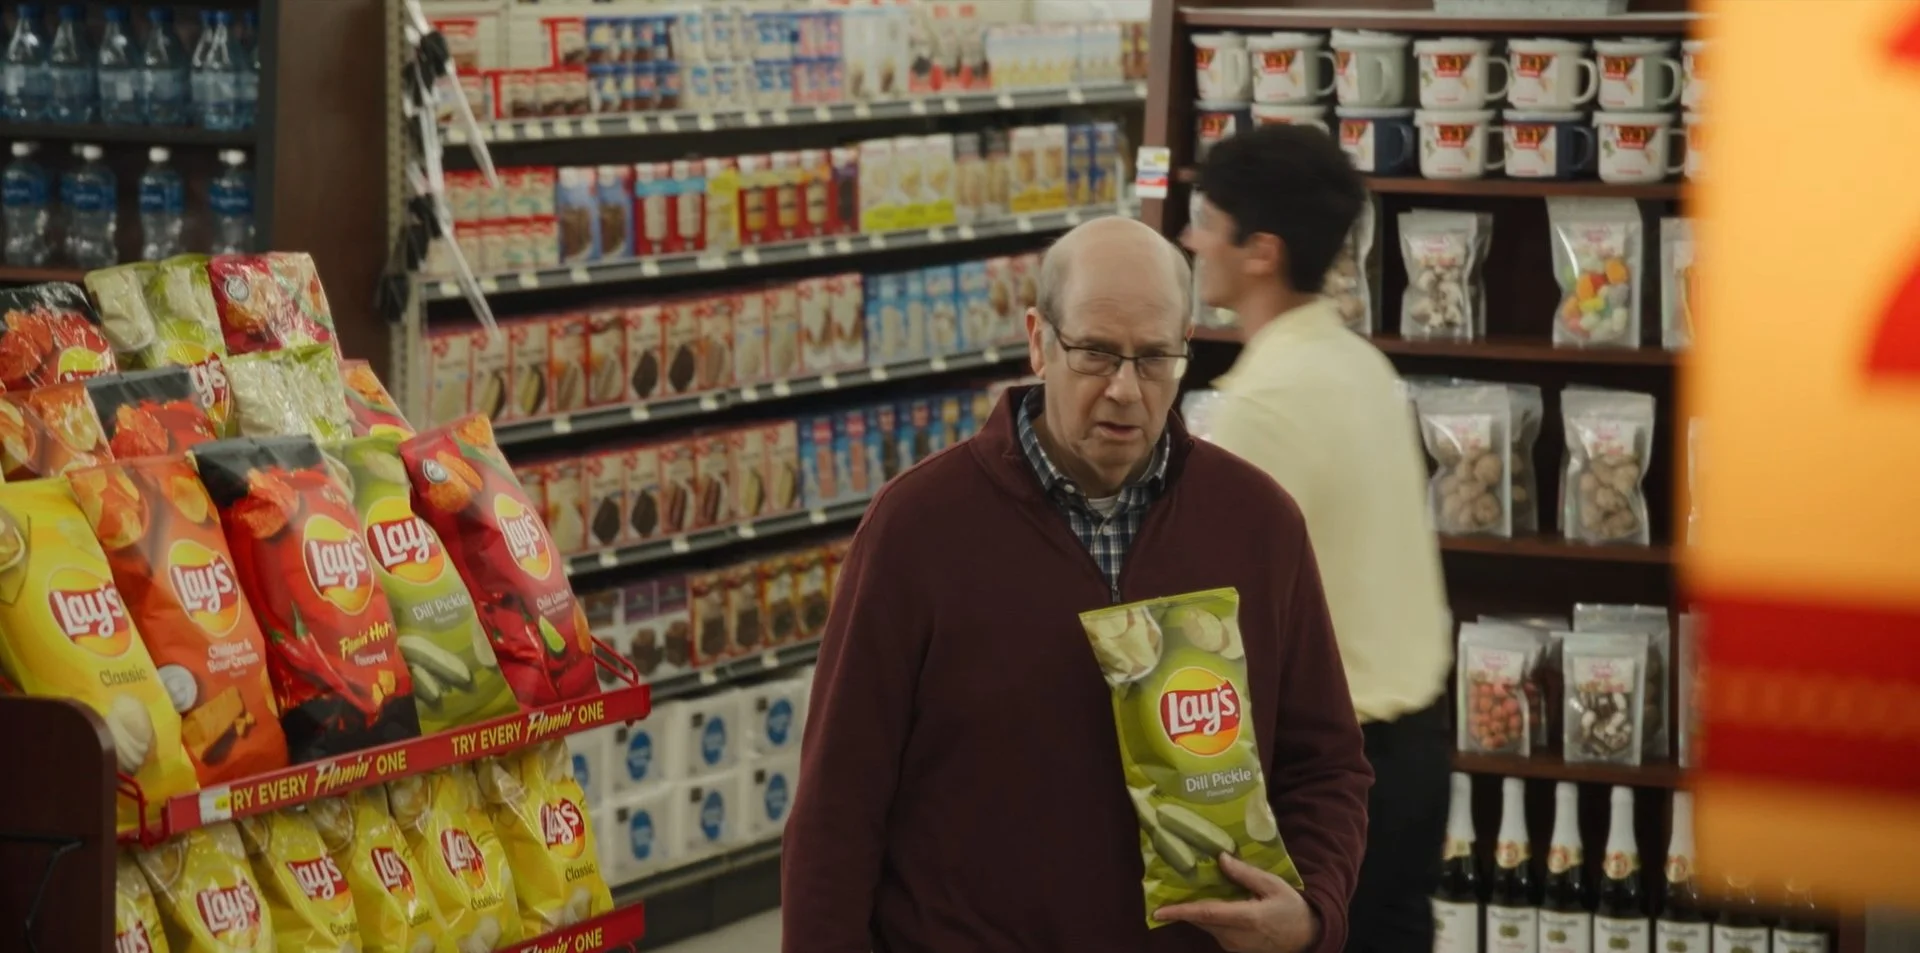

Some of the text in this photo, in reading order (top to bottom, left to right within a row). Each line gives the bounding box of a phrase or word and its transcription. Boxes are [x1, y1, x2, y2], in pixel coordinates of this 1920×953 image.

[501, 512, 540, 560] Lay's
[173, 559, 232, 613] Lay's
[309, 535, 366, 591] Lay's
[52, 584, 124, 638] Lay's
[412, 600, 434, 622] Dill
[435, 593, 468, 614] Pickle
[99, 665, 148, 687] Classic
[451, 700, 604, 757] TRY EVERY Flamin' ONE
[1167, 685, 1236, 736] Lay's
[259, 775, 308, 804] EVERY
[314, 755, 373, 795] Flamin'
[376, 749, 407, 776] ONE
[1186, 767, 1252, 792] Dill Pickle
[565, 862, 596, 883] Classic
[201, 883, 256, 931] Lay's
[575, 927, 603, 953] ONE
